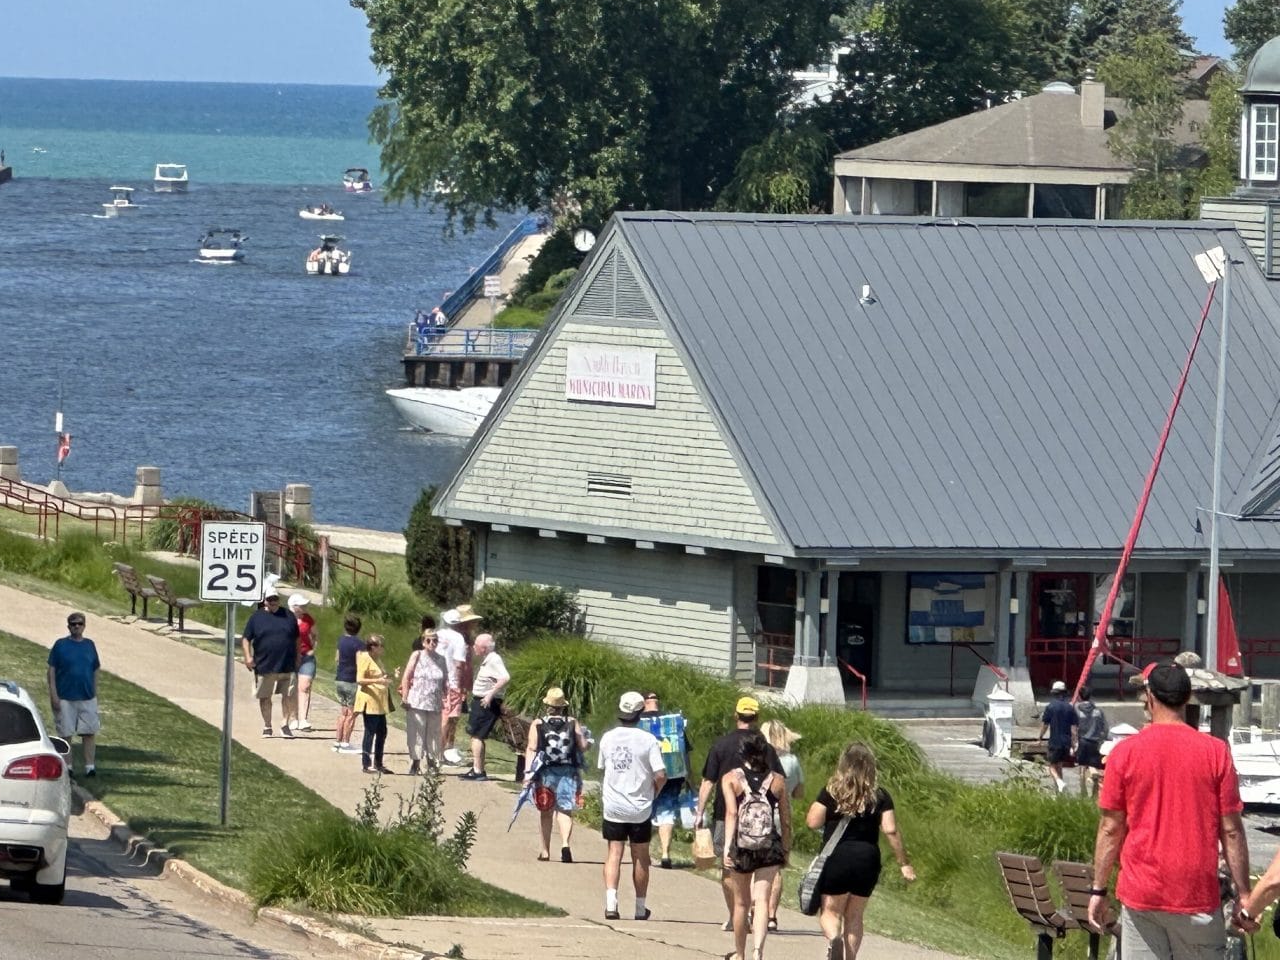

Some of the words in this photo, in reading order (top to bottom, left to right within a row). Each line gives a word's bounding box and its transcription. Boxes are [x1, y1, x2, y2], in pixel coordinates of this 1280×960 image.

[208, 531, 259, 544] SPEED
[213, 547, 252, 560] LIMIT
[207, 563, 257, 592] 25
